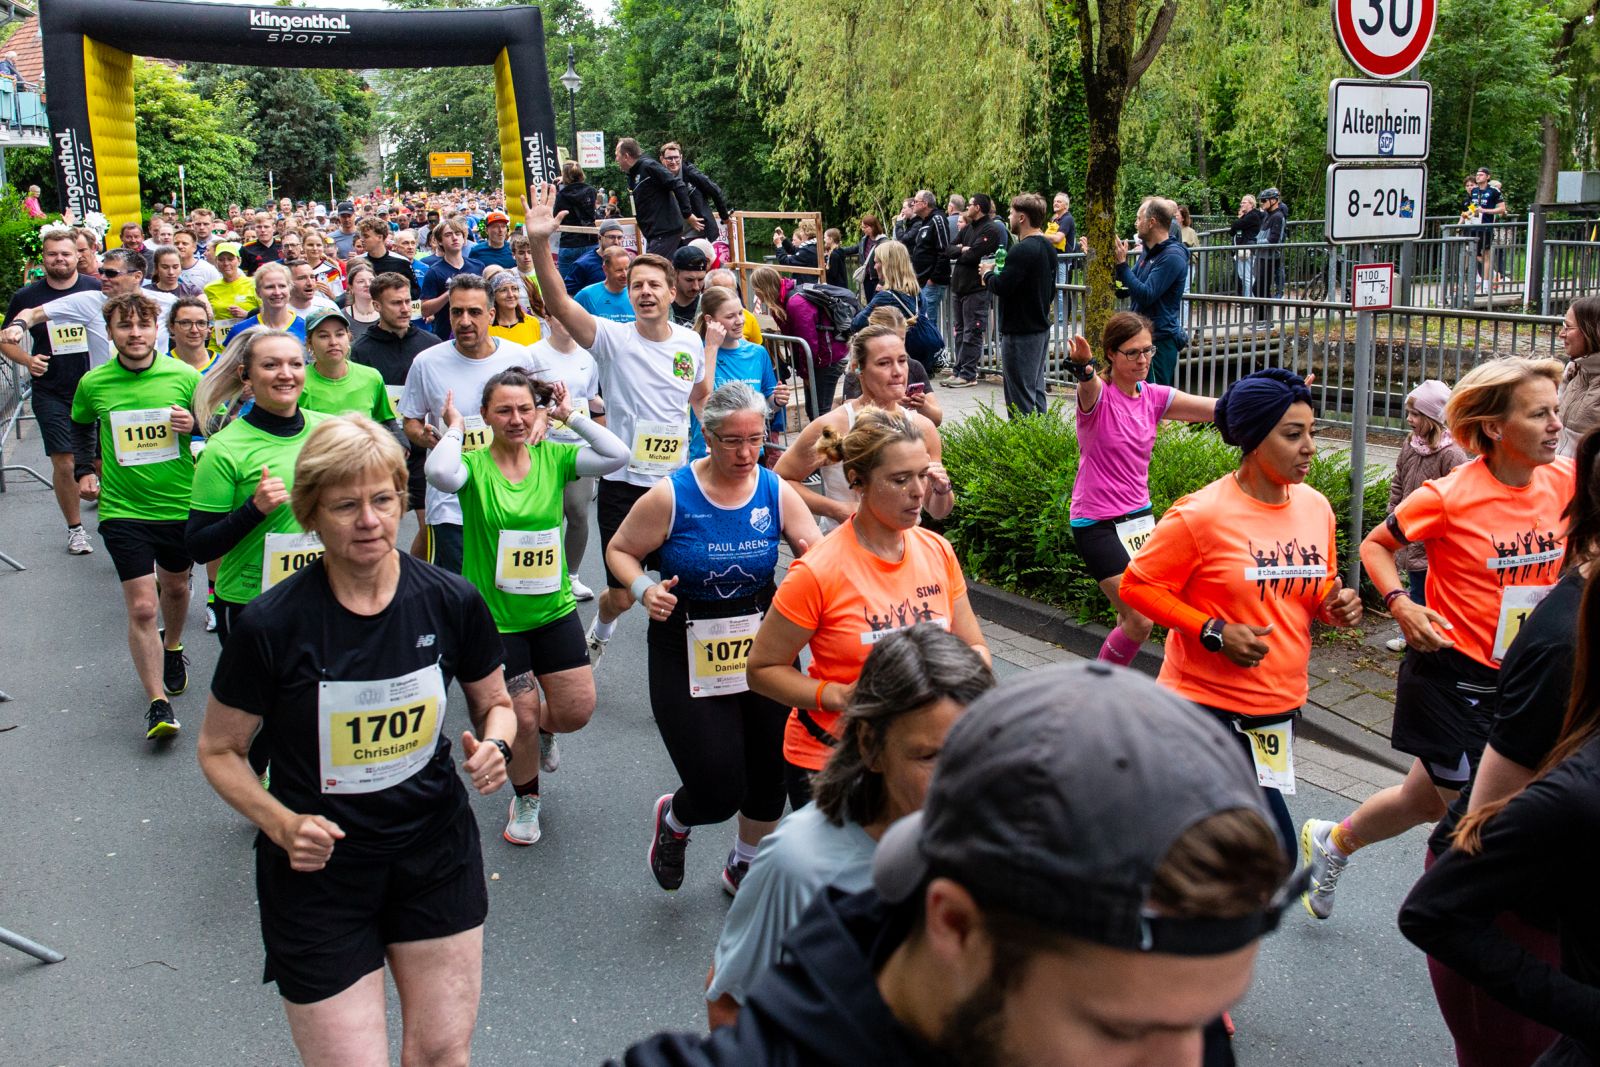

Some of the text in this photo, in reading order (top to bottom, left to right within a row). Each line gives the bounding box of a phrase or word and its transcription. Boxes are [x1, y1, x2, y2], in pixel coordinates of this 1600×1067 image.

[250, 9, 351, 32] klingenthal.
[1359, 0, 1414, 37] 30
[267, 34, 337, 44] SPORT
[1342, 107, 1421, 135] Altenheim
[80, 143, 99, 210] SPORT
[56, 326, 84, 339] 1167
[124, 424, 168, 442] 1103
[644, 437, 679, 453] 1733
[648, 453, 671, 461] Michael
[708, 539, 769, 552] PAUL ARENS
[280, 550, 326, 572] 109
[512, 548, 554, 567] 1815
[916, 583, 942, 599] SINA
[705, 638, 754, 662] 1072
[715, 661, 746, 672] Daniela
[345, 703, 426, 745] 1707
[353, 738, 419, 760] Christiane
